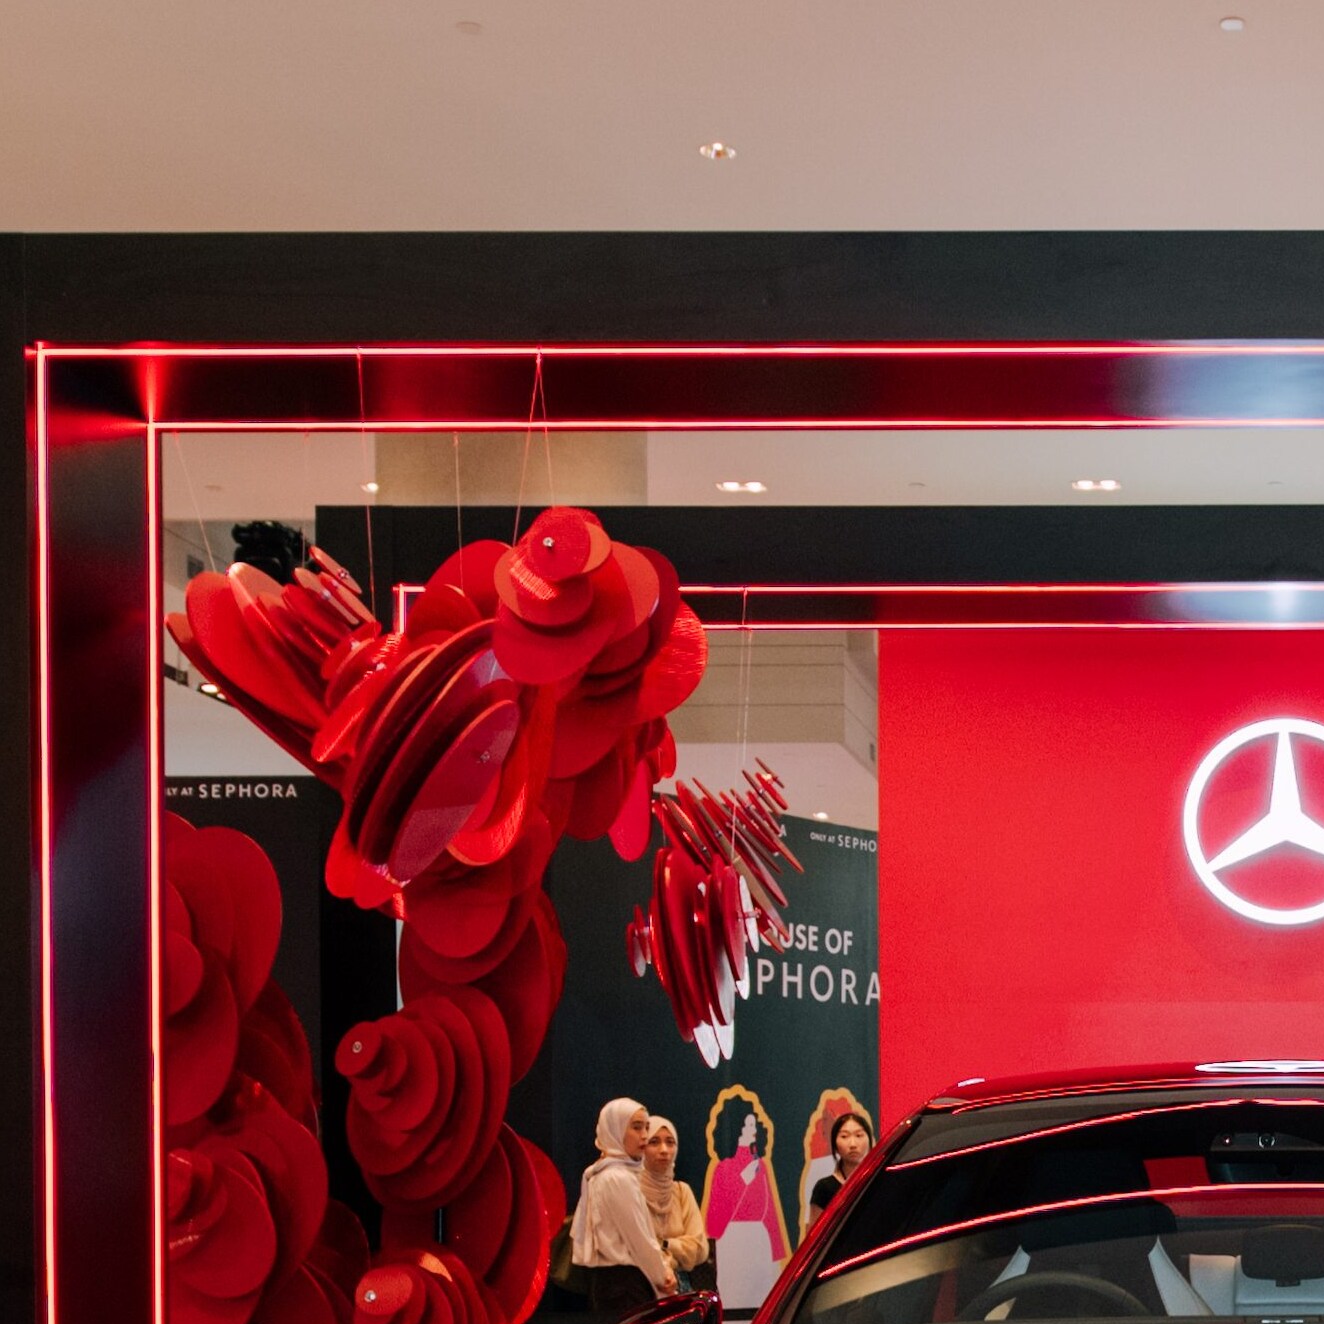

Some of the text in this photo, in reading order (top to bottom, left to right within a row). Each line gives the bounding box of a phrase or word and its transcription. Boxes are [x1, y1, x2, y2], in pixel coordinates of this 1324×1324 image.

[181, 787, 193, 796] AT
[198, 784, 298, 798] SEPHORA
[809, 832, 827, 843] ONLY
[837, 834, 878, 853] SEPHO
[824, 927, 854, 956] OF
[756, 957, 881, 1006] PHORA
